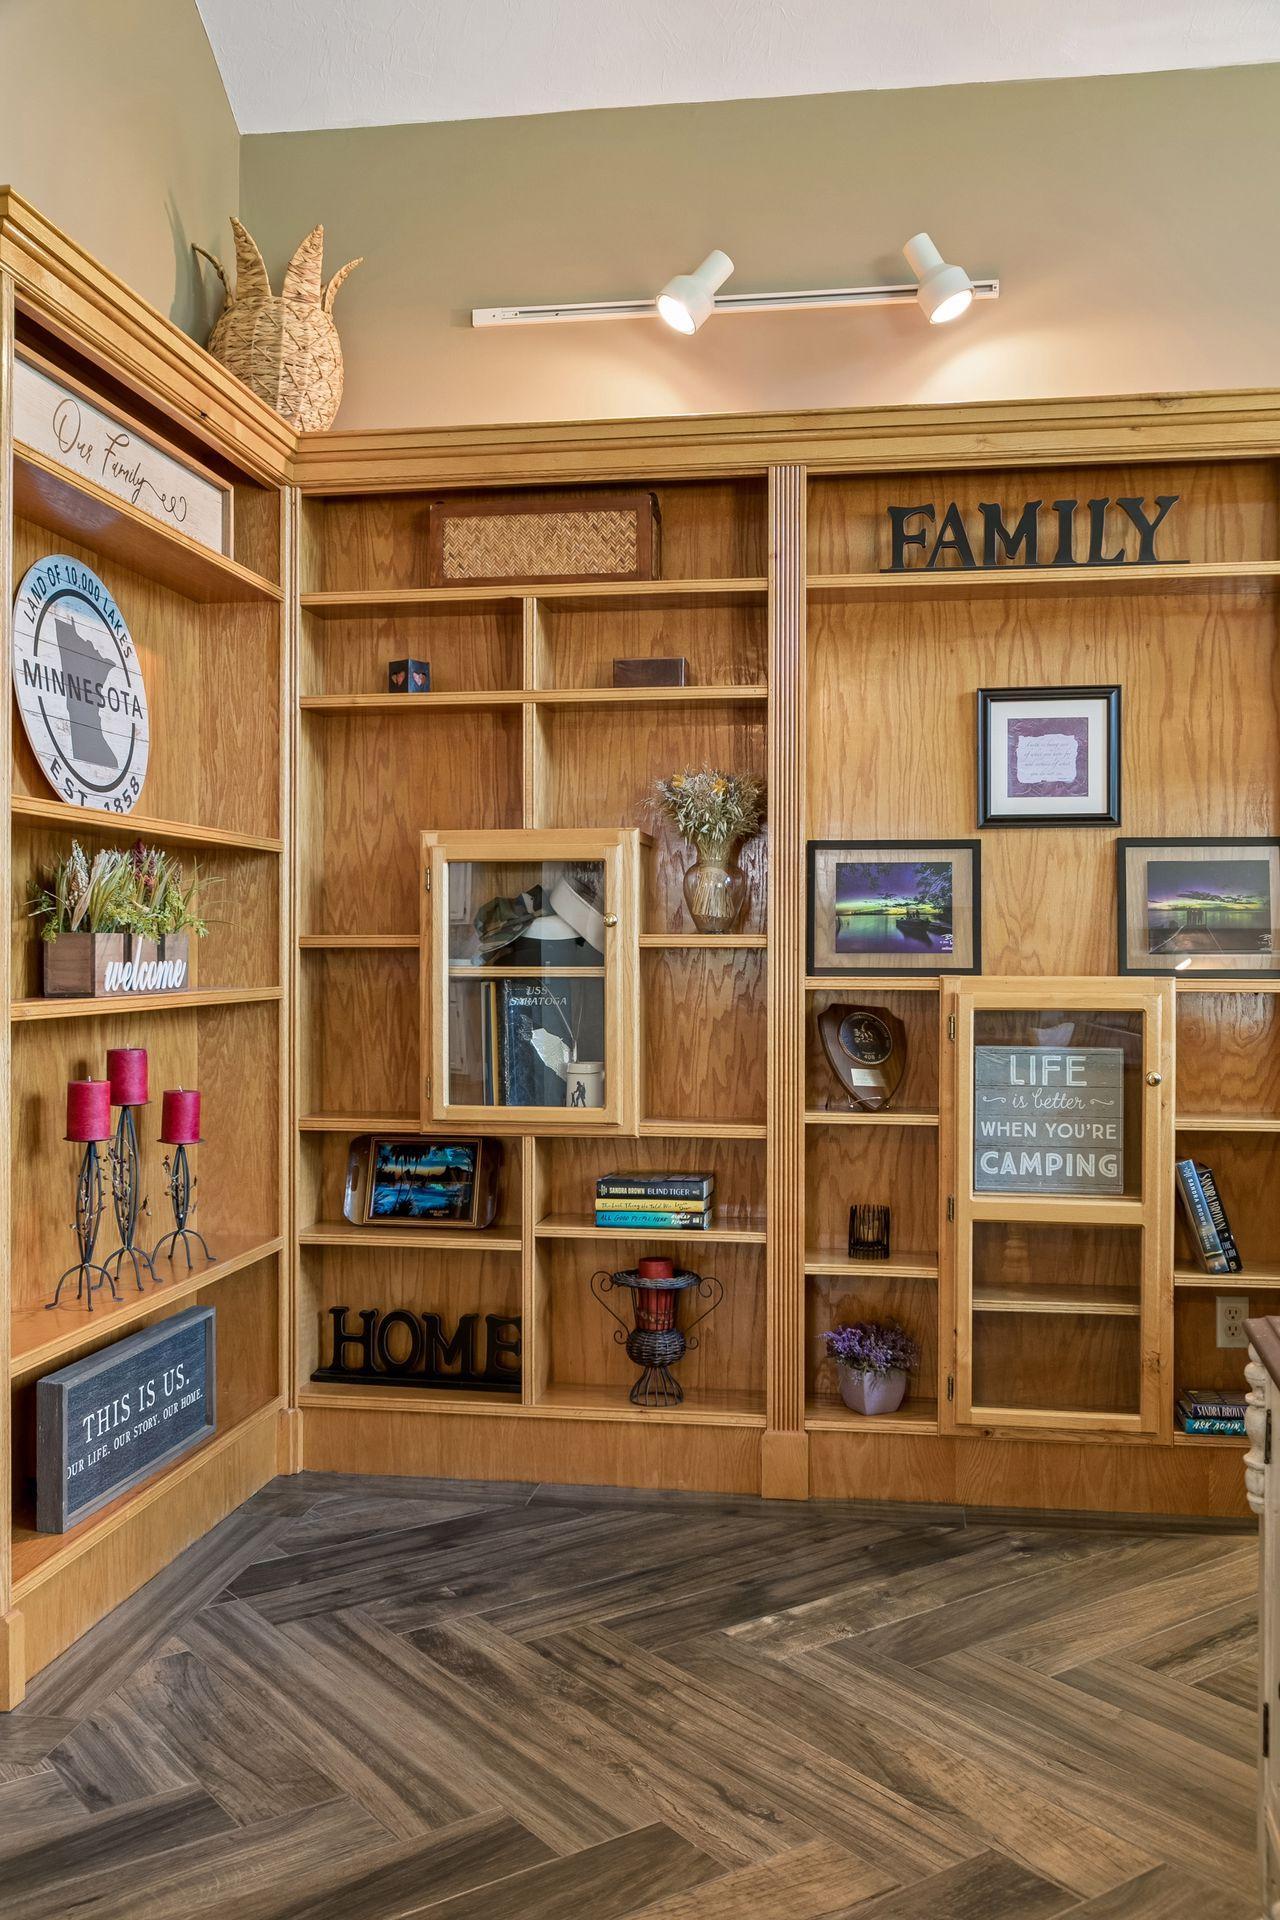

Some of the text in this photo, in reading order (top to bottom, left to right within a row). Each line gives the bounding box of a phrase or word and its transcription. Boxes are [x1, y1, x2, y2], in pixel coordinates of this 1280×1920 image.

[53, 399, 162, 504] Our Family
[887, 496, 1179, 568] FAMILY
[24, 576, 48, 624] LAND
[47, 564, 61, 587] OF
[102, 598, 133, 659] LAKES
[23, 659, 143, 719] MINNESOTA
[104, 934, 187, 992] welcome
[526, 986, 548, 995] USS
[1010, 1055, 1088, 1086] LIFE
[1012, 1087, 1086, 1110] is better
[981, 1121, 1117, 1139] WHEN YOU'RE
[980, 1151, 1118, 1178] CAMPING
[647, 1187, 669, 1195] BLIND
[329, 1306, 522, 1377] HOME
[82, 1363, 190, 1443] THIS IS US.
[1197, 1405, 1220, 1416] SANDRA
[87, 1444, 111, 1467] LIFE.
[113, 1431, 131, 1450] OUR
[133, 1414, 160, 1438] STORY.
[163, 1402, 179, 1420] OUR
[181, 1388, 203, 1409] HOME.
[1192, 1421, 1212, 1430] ASK
